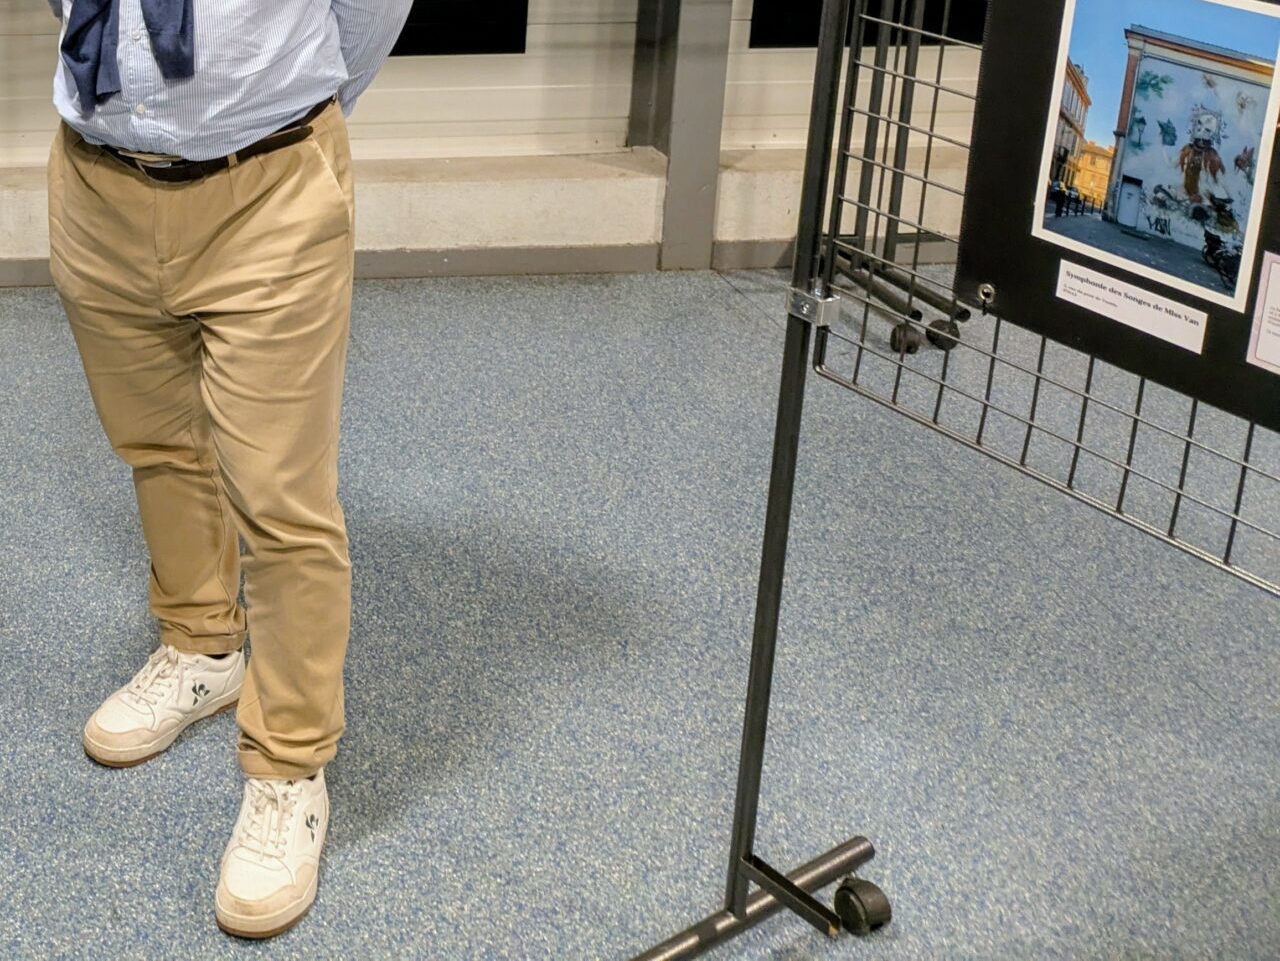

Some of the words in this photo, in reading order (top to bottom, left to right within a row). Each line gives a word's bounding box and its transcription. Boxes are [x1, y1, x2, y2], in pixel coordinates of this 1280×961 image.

[1065, 270, 1108, 290] Symphonie
[1108, 285, 1122, 296] des
[1123, 291, 1151, 308] Songes
[1152, 302, 1163, 312] de
[1164, 305, 1182, 320] Miss
[1183, 314, 1200, 327] Van
